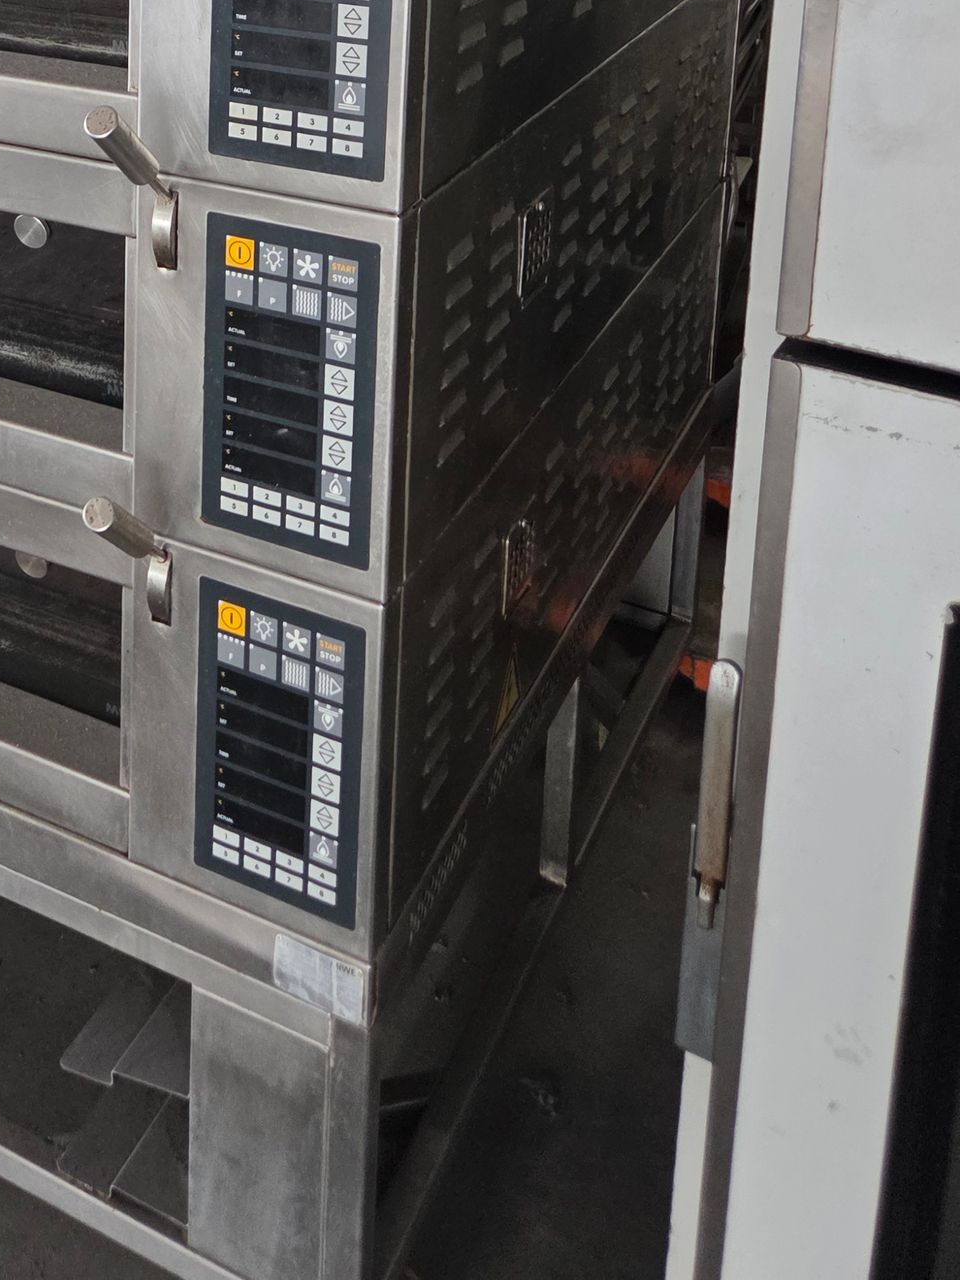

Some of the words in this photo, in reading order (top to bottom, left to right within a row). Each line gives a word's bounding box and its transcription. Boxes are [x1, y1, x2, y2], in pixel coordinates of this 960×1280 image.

[332, 262, 356, 274] START
[332, 274, 354, 284] STOP
[320, 651, 341, 663] STOP
